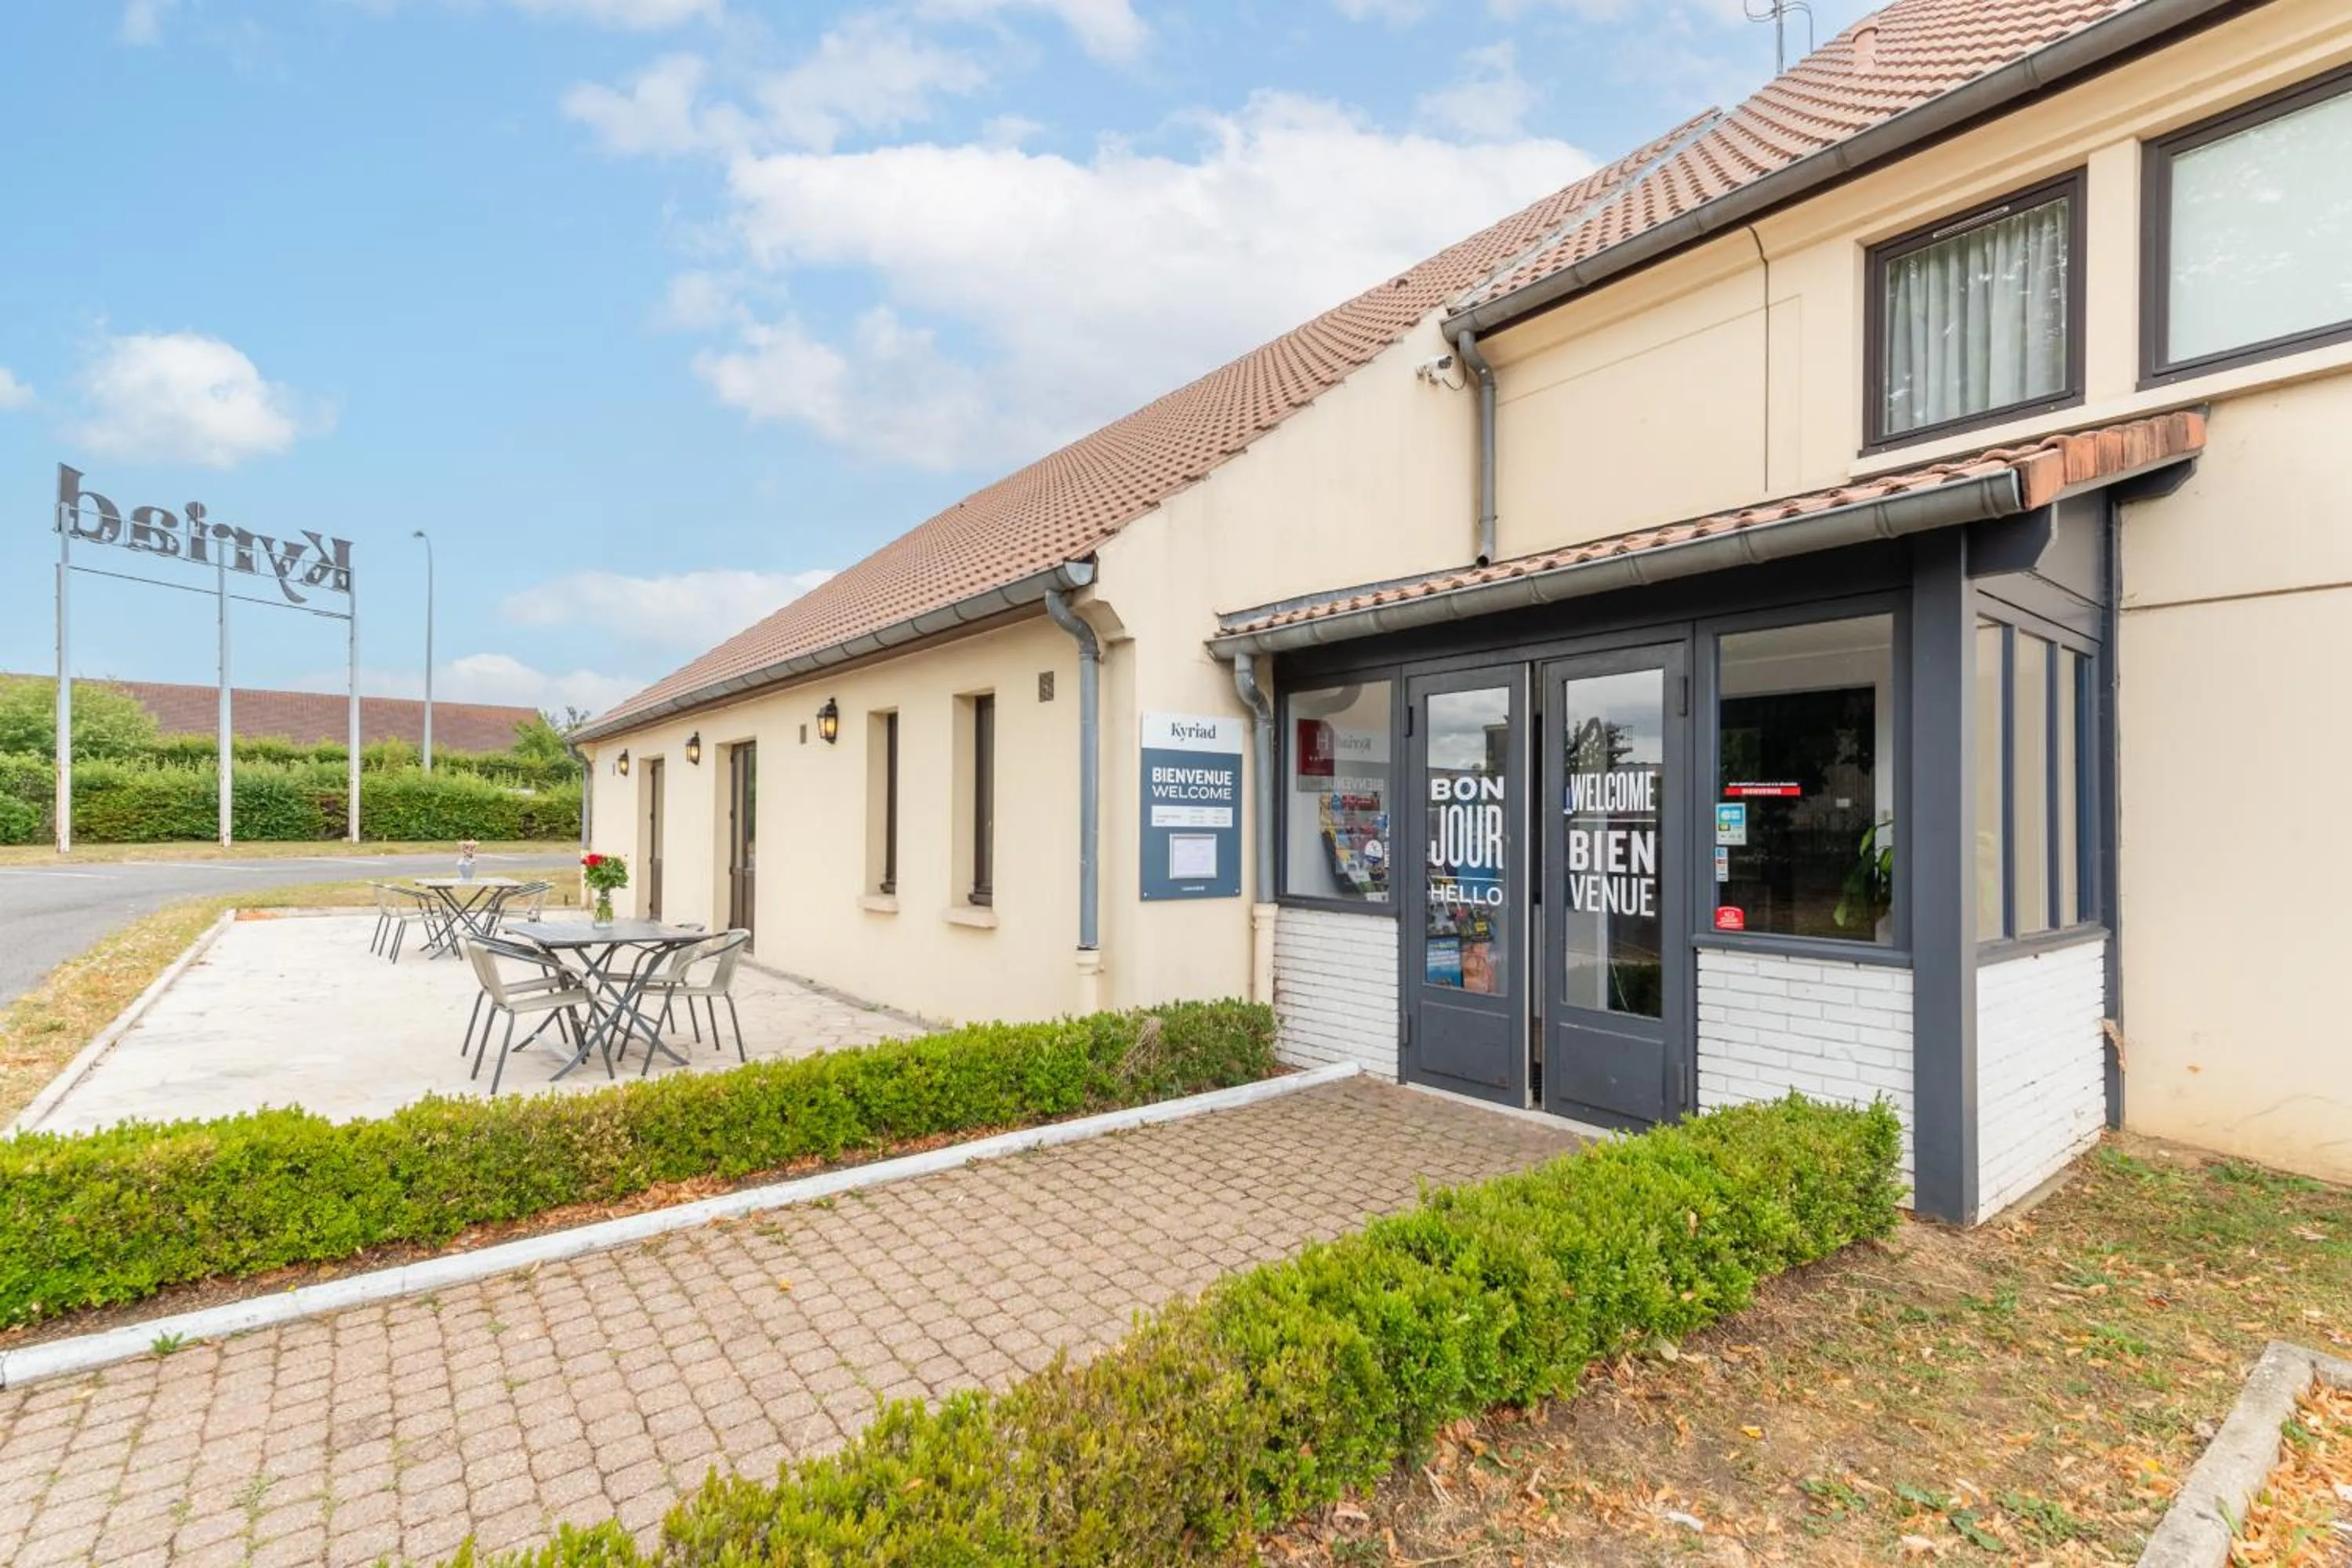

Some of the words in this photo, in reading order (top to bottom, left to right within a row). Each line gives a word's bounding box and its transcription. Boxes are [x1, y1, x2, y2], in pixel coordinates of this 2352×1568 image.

[1171, 721, 1217, 742] Kyriad
[1152, 767, 1232, 786] BIENVENUE
[1431, 775, 1504, 800] BON
[1152, 784, 1232, 800] WELCOME
[1570, 771, 1657, 812] WELCOME
[1431, 804, 1504, 869] JOUR
[1569, 829, 1656, 875] BIEN
[1431, 883, 1504, 906] HELLO
[1569, 873, 1656, 917] VENUE
